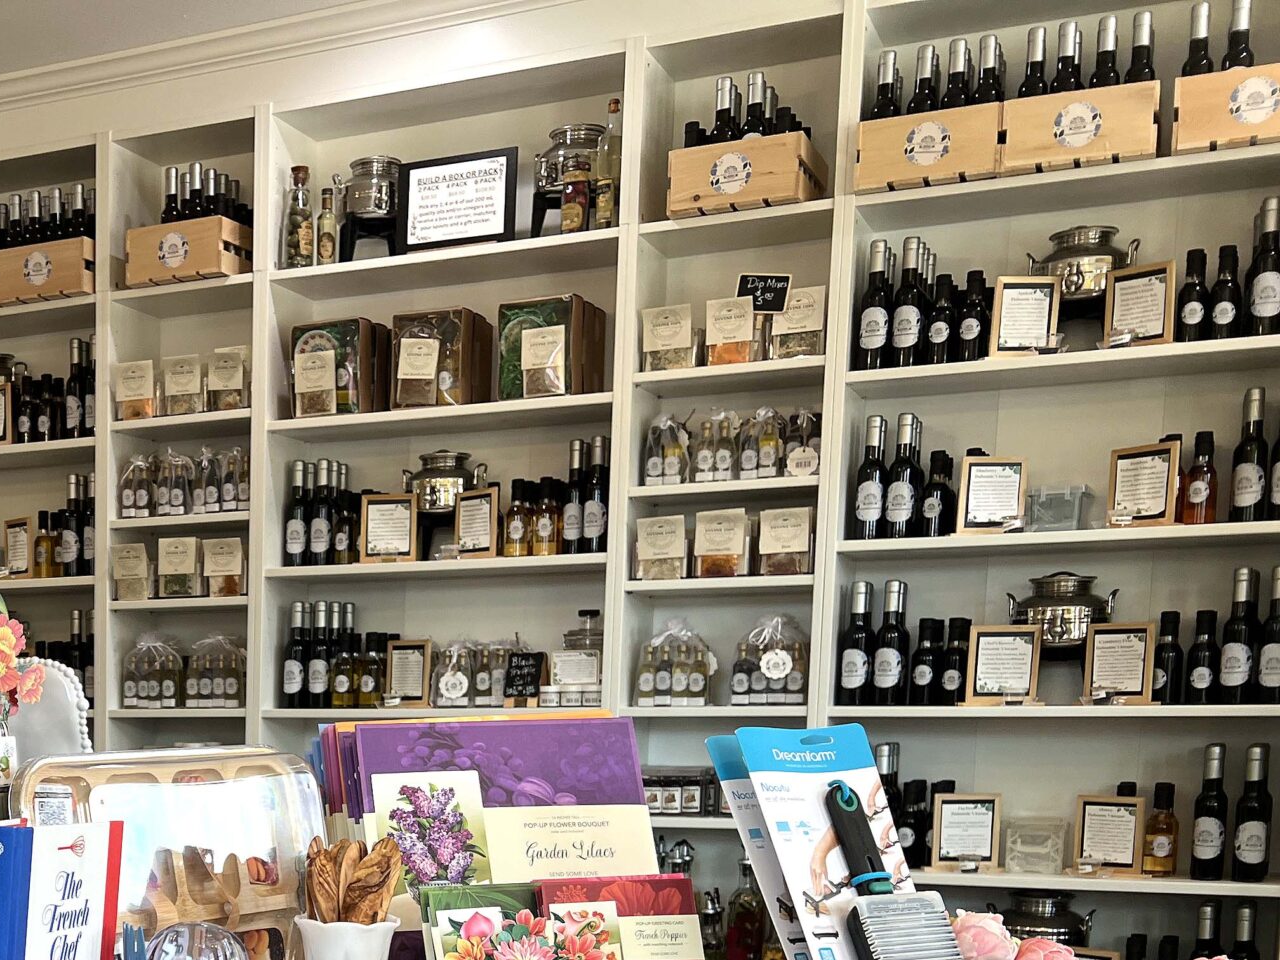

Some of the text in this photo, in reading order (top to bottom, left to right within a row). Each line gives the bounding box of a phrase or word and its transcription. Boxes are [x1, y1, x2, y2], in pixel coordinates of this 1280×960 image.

[418, 176, 440, 186] BUILD
[449, 172, 464, 180] BOX
[466, 171, 477, 179] OR
[478, 167, 498, 177] PACK
[747, 277, 787, 289] Dip Mixes
[772, 748, 836, 761] Dreamfarm
[731, 790, 758, 801] Nocut
[577, 820, 610, 828] BOUQUET
[525, 840, 617, 867] Garden Lilacs
[55, 870, 83, 901] The
[42, 899, 90, 935] French
